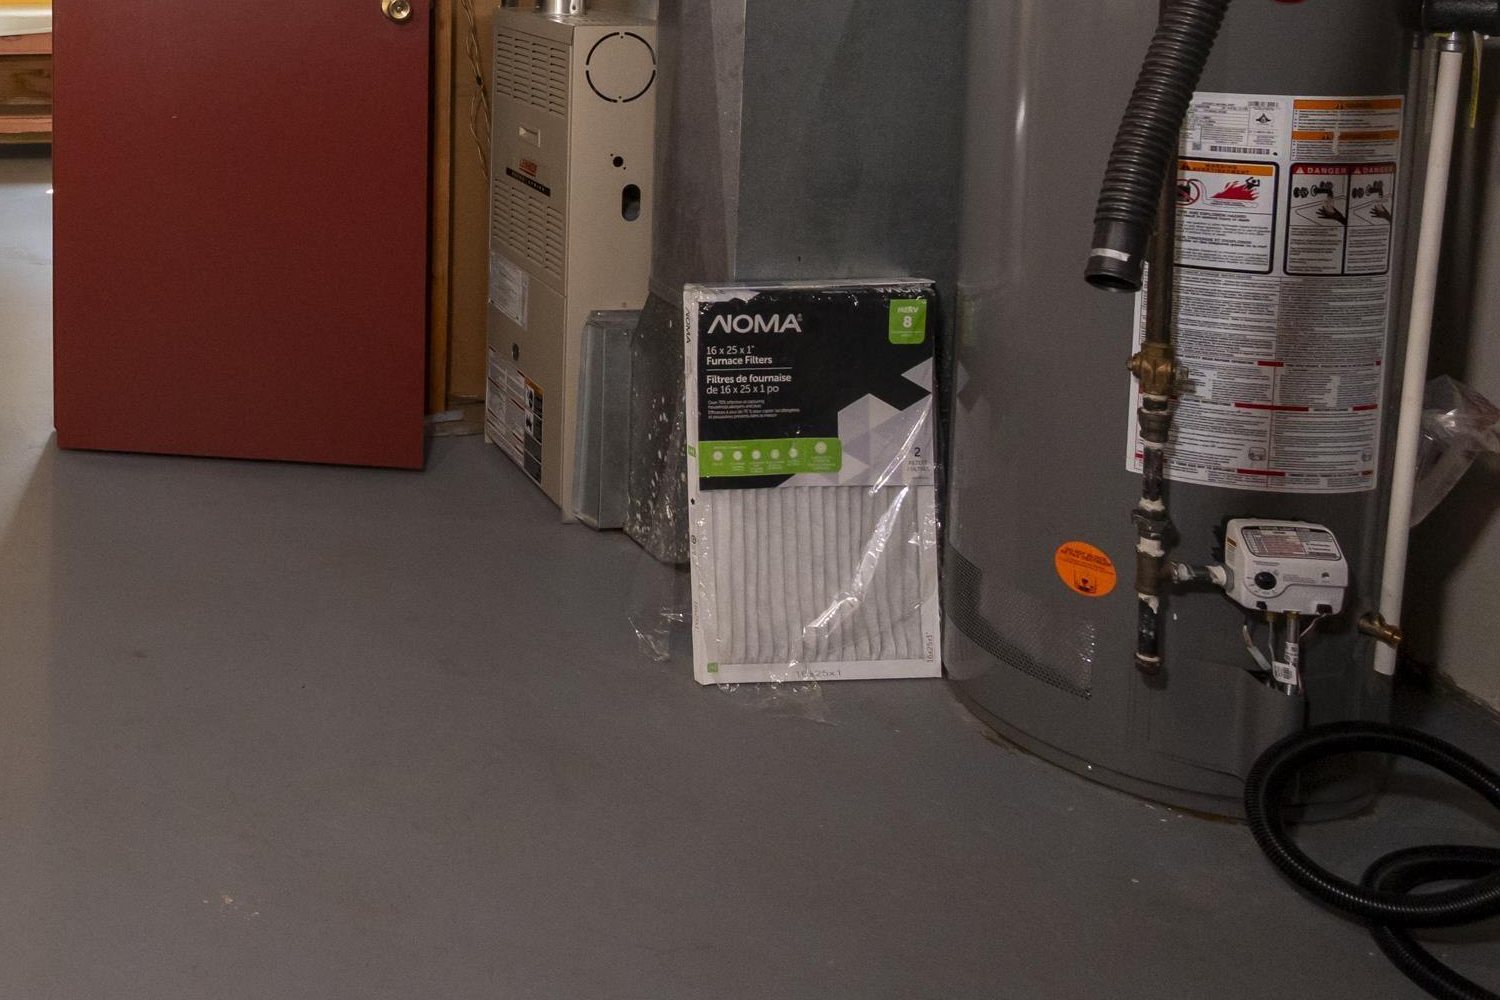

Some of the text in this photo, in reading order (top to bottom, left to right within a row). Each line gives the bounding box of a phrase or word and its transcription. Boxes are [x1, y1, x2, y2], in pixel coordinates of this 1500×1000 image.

[707, 313, 802, 334] NOMA
[902, 316, 913, 328] 8
[706, 345, 717, 355] 16
[726, 345, 738, 355] 25
[706, 355, 773, 366] Furnace Filters
[706, 374, 792, 384] Filtres de fournaise
[706, 386, 718, 395] de
[720, 385, 731, 394] 16
[740, 385, 751, 394] 25
[760, 384, 765, 393] 1
[767, 385, 780, 395] po
[914, 447, 921, 457] 2
